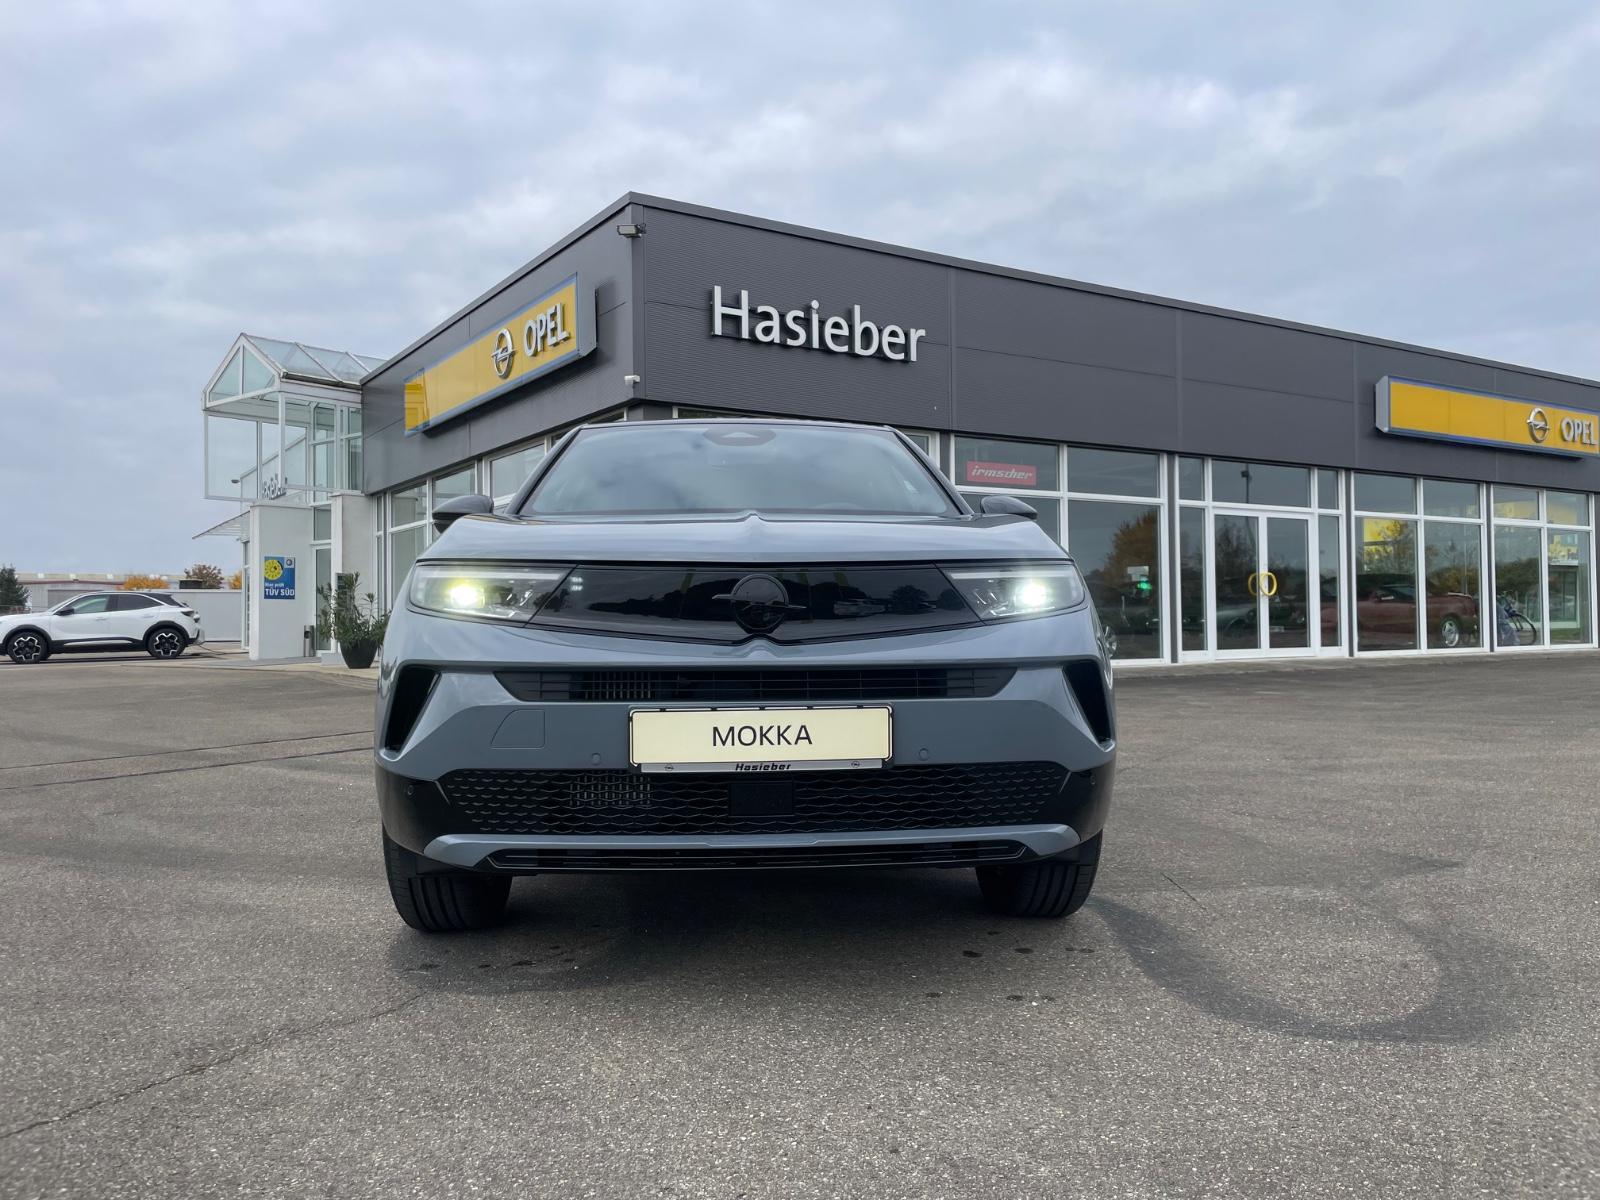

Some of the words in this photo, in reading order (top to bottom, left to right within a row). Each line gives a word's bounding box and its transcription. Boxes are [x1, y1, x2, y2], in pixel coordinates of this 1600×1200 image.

[524, 303, 570, 356] OPEL
[712, 285, 926, 362] Hasieber
[1561, 417, 1597, 445] OPEL
[972, 465, 1033, 480] irmscher
[265, 587, 279, 596] TÜV
[280, 587, 295, 596] SÜD
[712, 725, 813, 747] MOKKA
[735, 763, 792, 772] Hasieber
